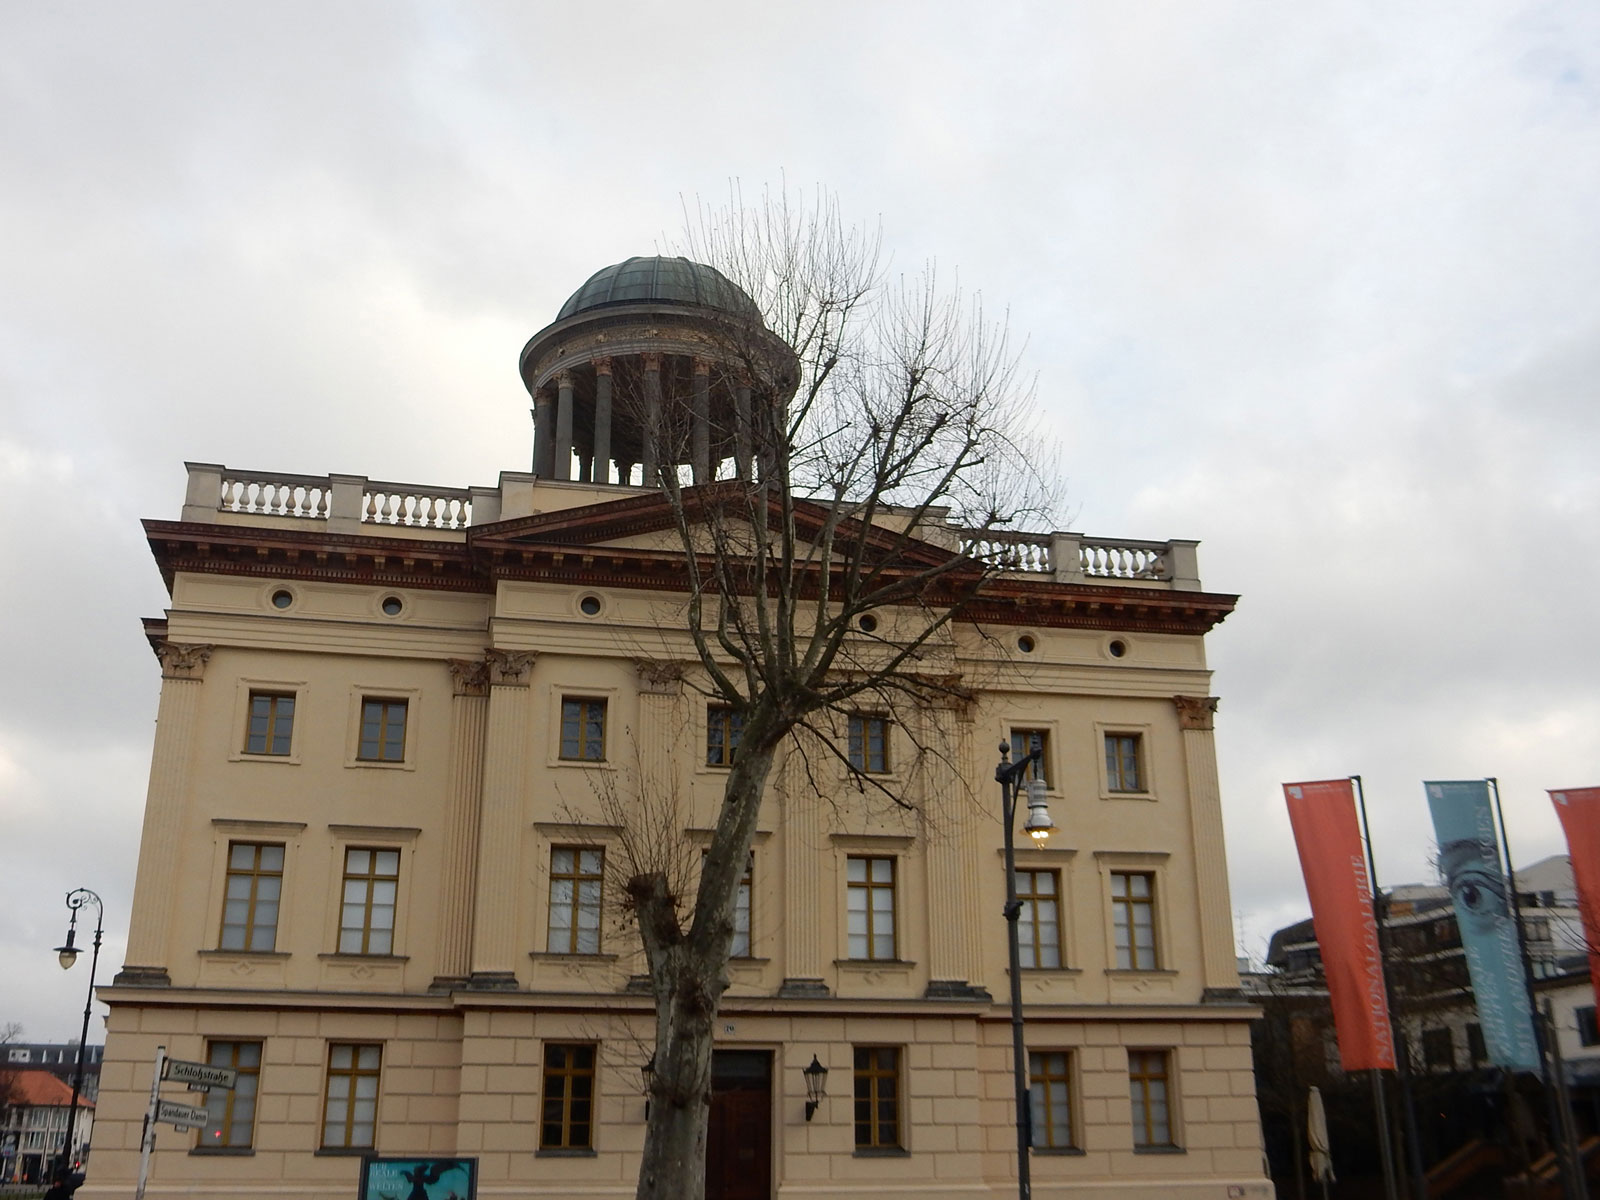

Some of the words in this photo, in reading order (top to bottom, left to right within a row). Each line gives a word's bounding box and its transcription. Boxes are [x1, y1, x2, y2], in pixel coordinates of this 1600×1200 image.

[1350, 855, 1392, 1061] NATIONALGALERIE
[174, 1065, 229, 1083] Schloßstraße
[161, 1106, 190, 1119] Spandauer
[190, 1109, 207, 1120] Damm
